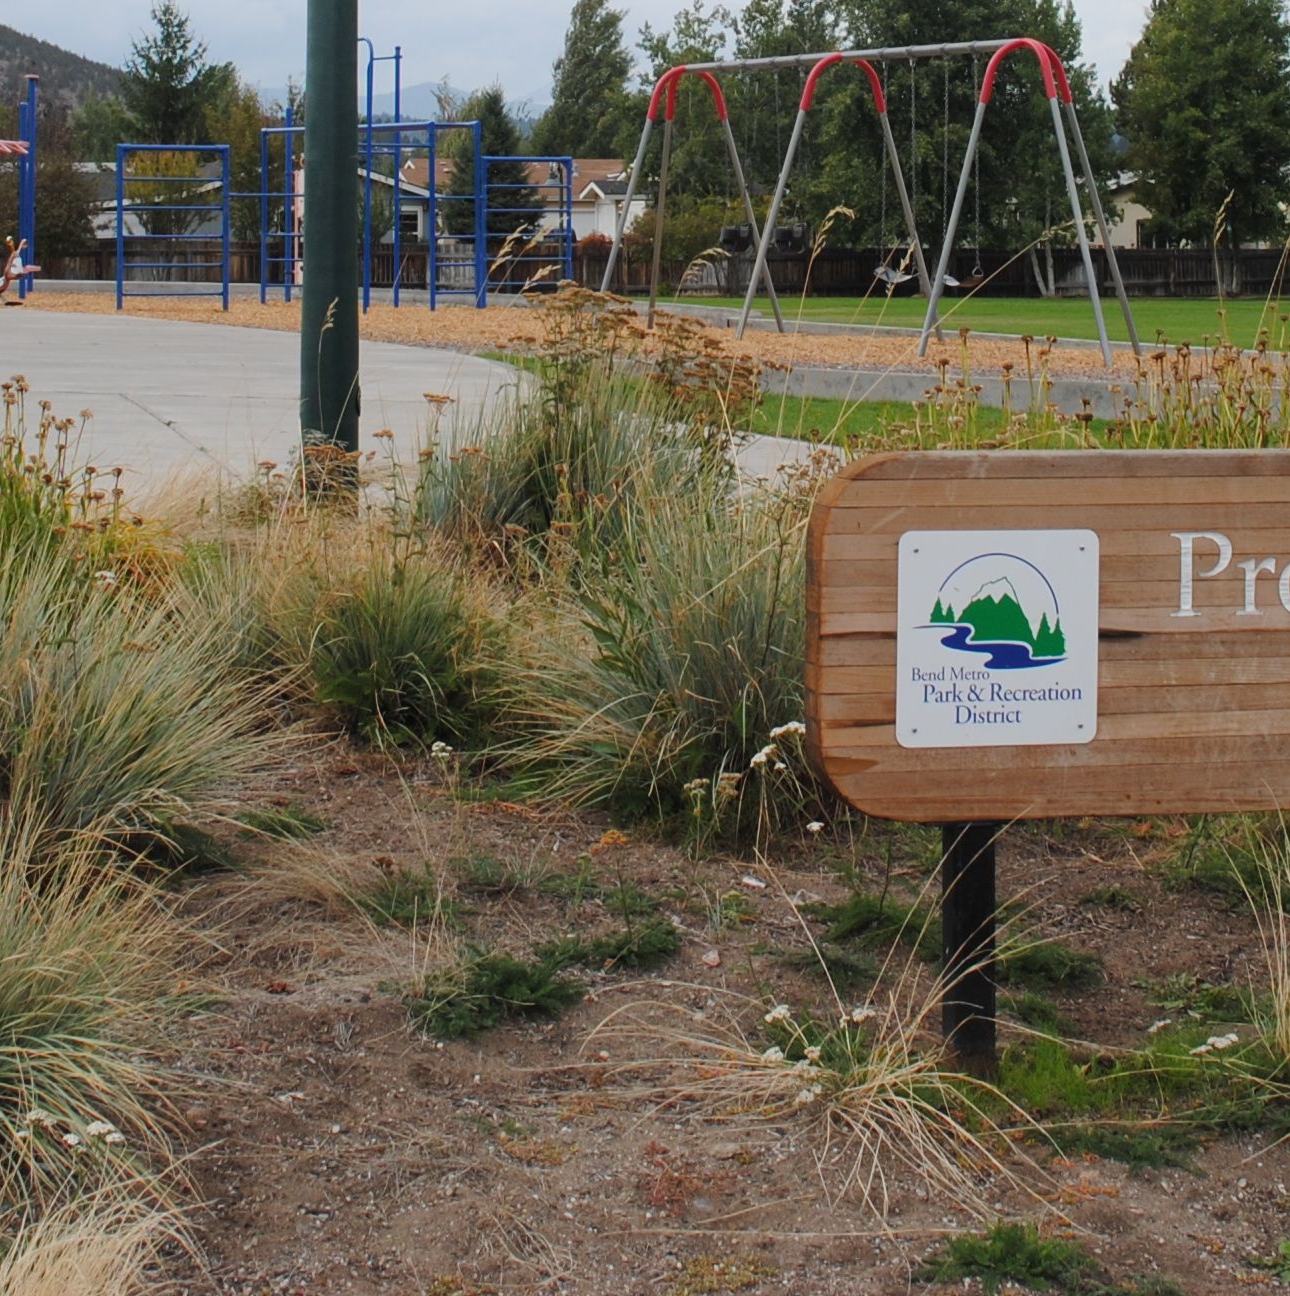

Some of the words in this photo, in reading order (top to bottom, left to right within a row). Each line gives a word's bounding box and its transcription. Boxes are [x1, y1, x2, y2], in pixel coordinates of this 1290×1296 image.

[911, 667, 945, 681] Bend
[950, 667, 990, 681] Metro
[923, 683, 963, 703] Park
[967, 684, 985, 702] &
[990, 681, 1083, 702] Recreation
[955, 705, 1022, 724] District
